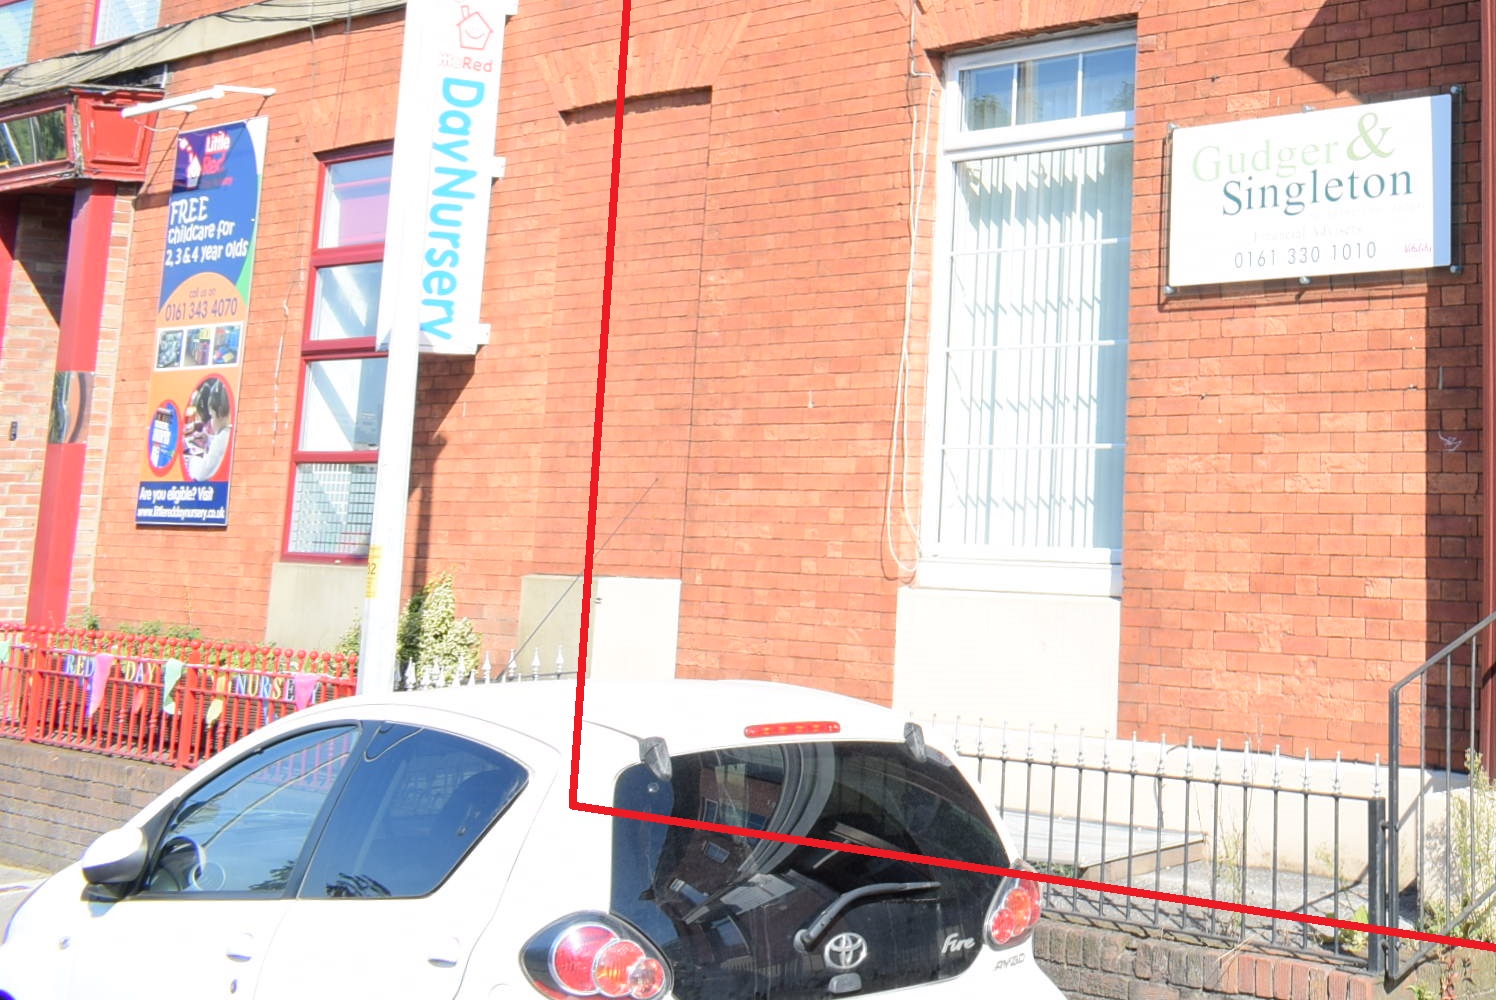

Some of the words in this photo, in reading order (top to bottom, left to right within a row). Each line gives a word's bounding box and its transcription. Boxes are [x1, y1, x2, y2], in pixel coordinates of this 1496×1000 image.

[1192, 139, 1341, 182] Gudger
[1346, 112, 1397, 162] &
[1222, 169, 1414, 216] Singleton
[170, 196, 209, 225] FREE
[168, 222, 216, 244] childcare
[217, 219, 236, 240] for
[200, 244, 224, 263] year
[225, 238, 249, 258] olds
[1234, 249, 1277, 269] 0161
[1287, 246, 1321, 265] 330
[1332, 241, 1377, 261] 1010
[165, 302, 187, 322] 0161
[189, 300, 208, 319] 343
[211, 298, 238, 317] 4070
[65, 653, 96, 678] RED
[124, 658, 156, 680] DAY
[941, 932, 976, 954] Fire
